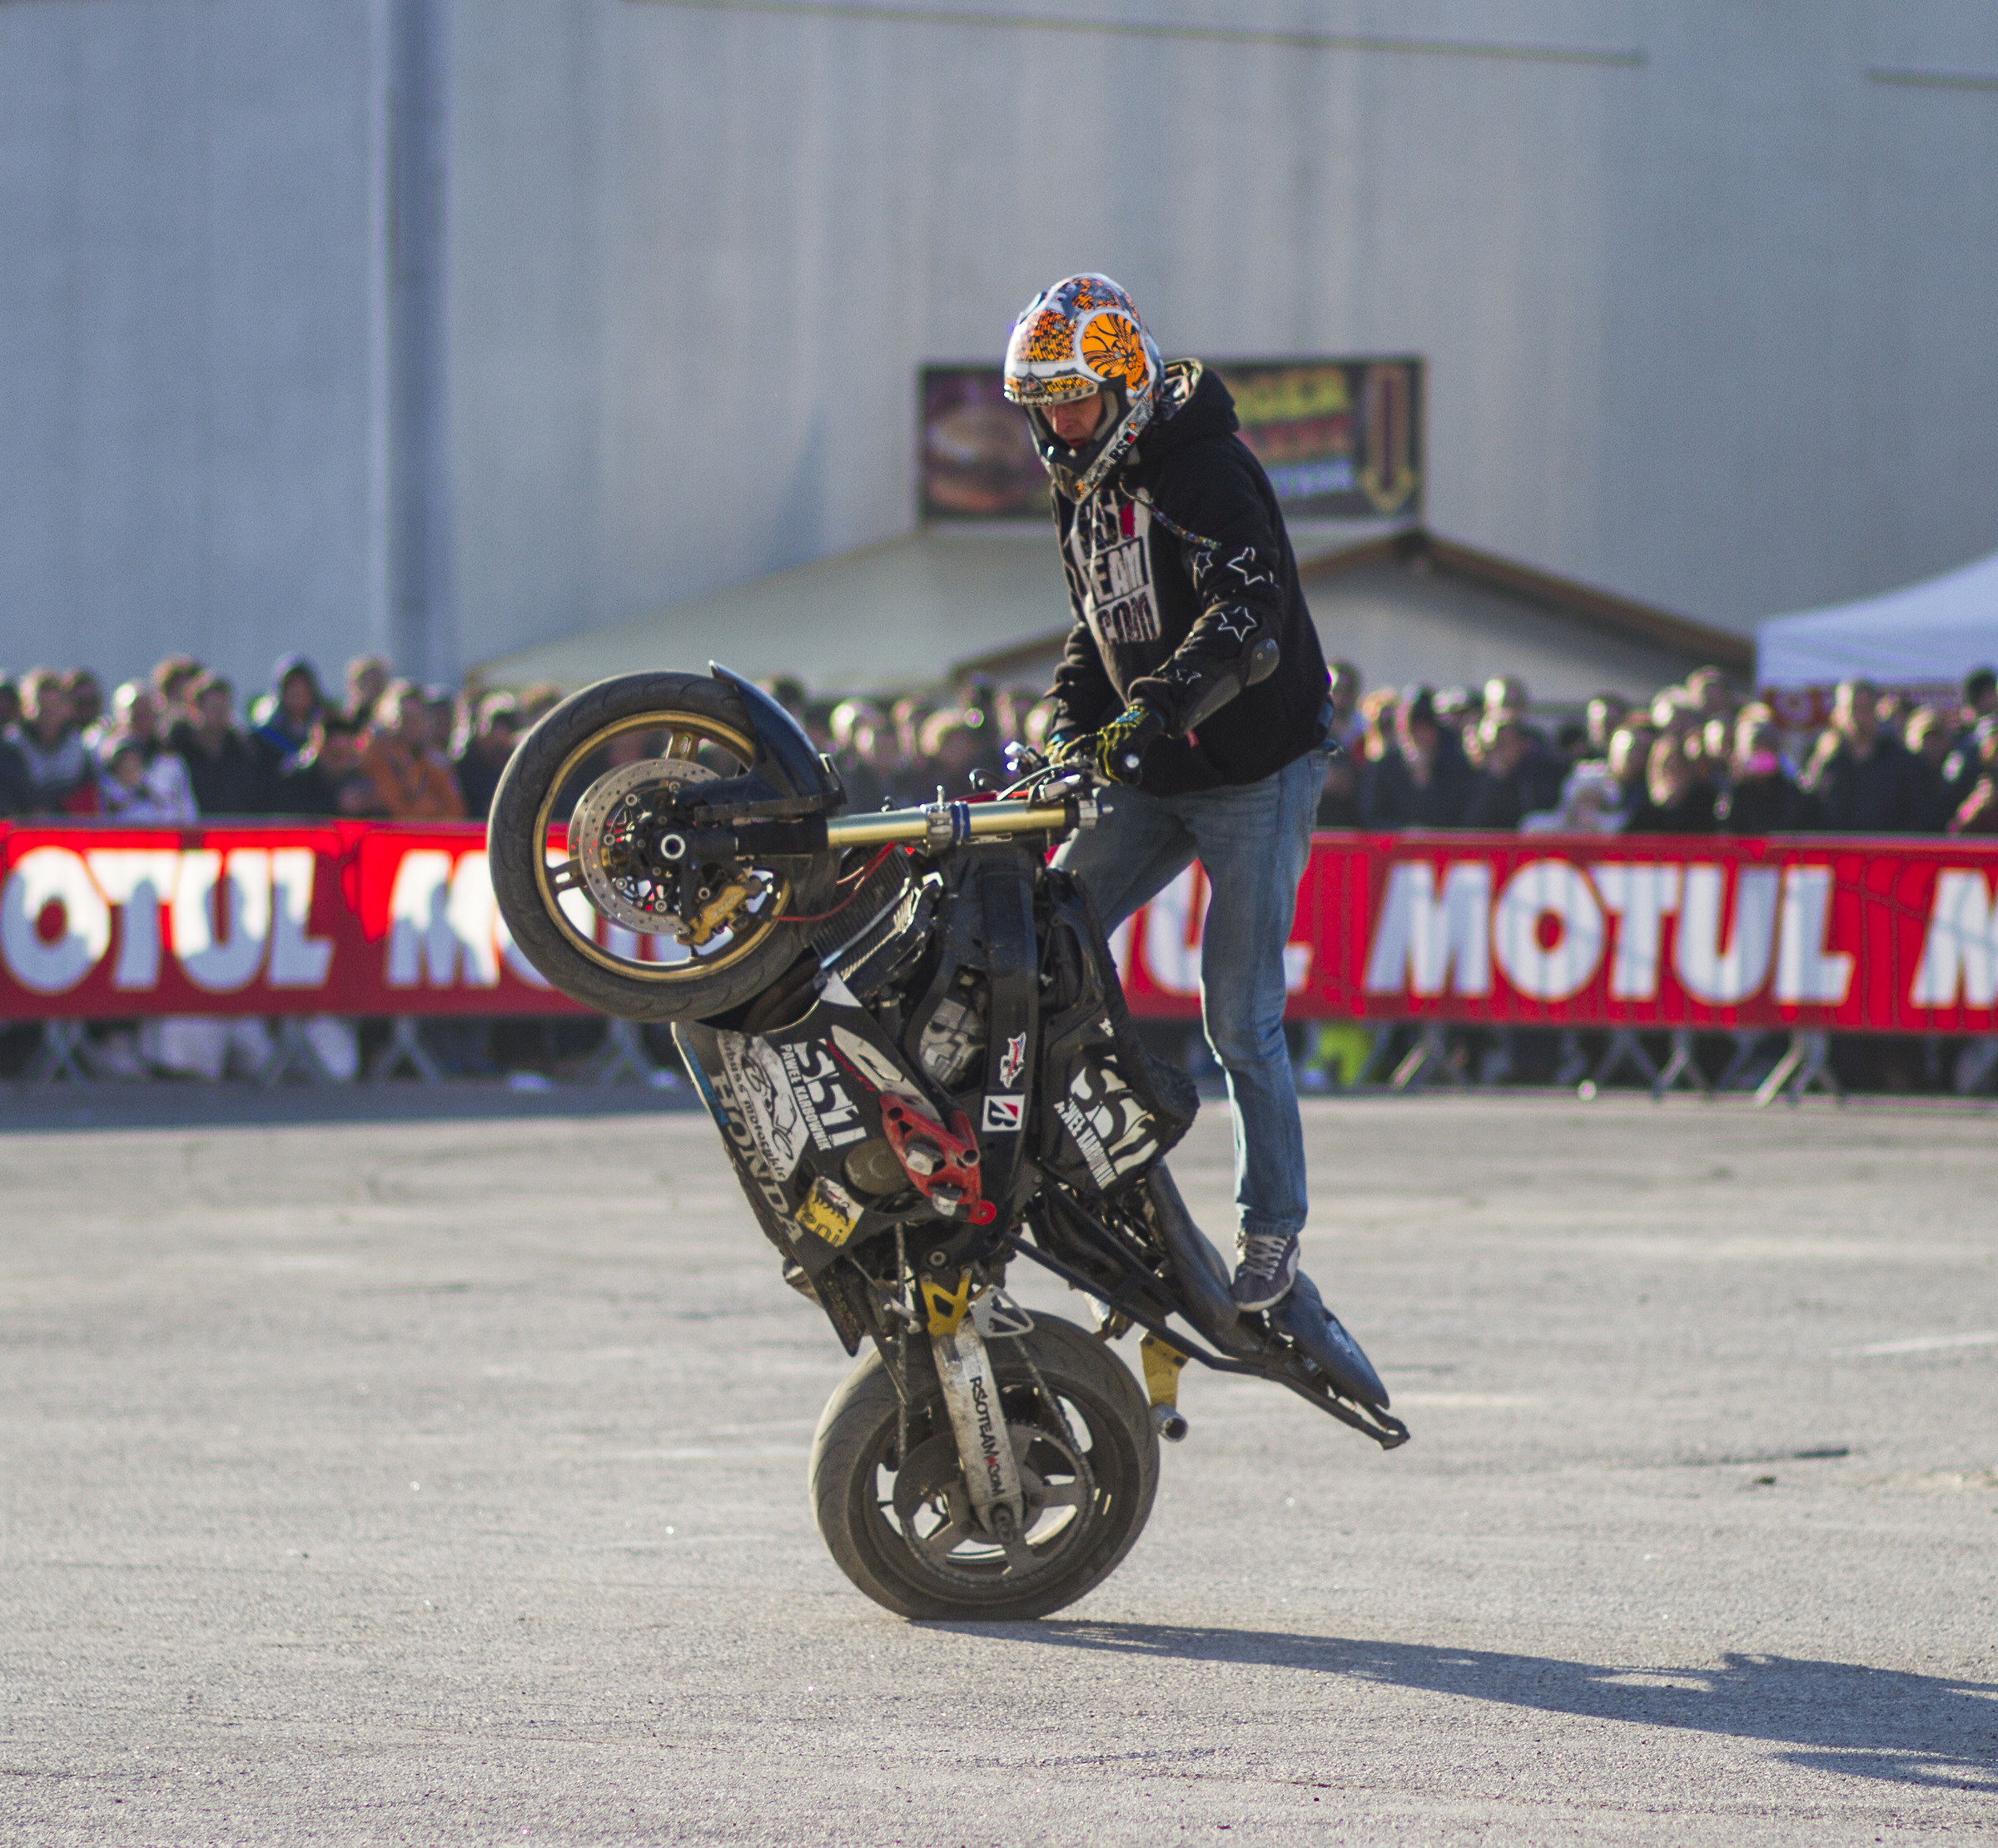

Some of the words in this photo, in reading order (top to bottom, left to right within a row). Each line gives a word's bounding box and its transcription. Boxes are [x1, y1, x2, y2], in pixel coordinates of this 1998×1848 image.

[1084, 541, 1145, 605] EAM
[1363, 860, 1855, 1006] MOTUL
[708, 1070, 804, 1245] HONDA
[793, 1084, 832, 1151] KARBOWNIK
